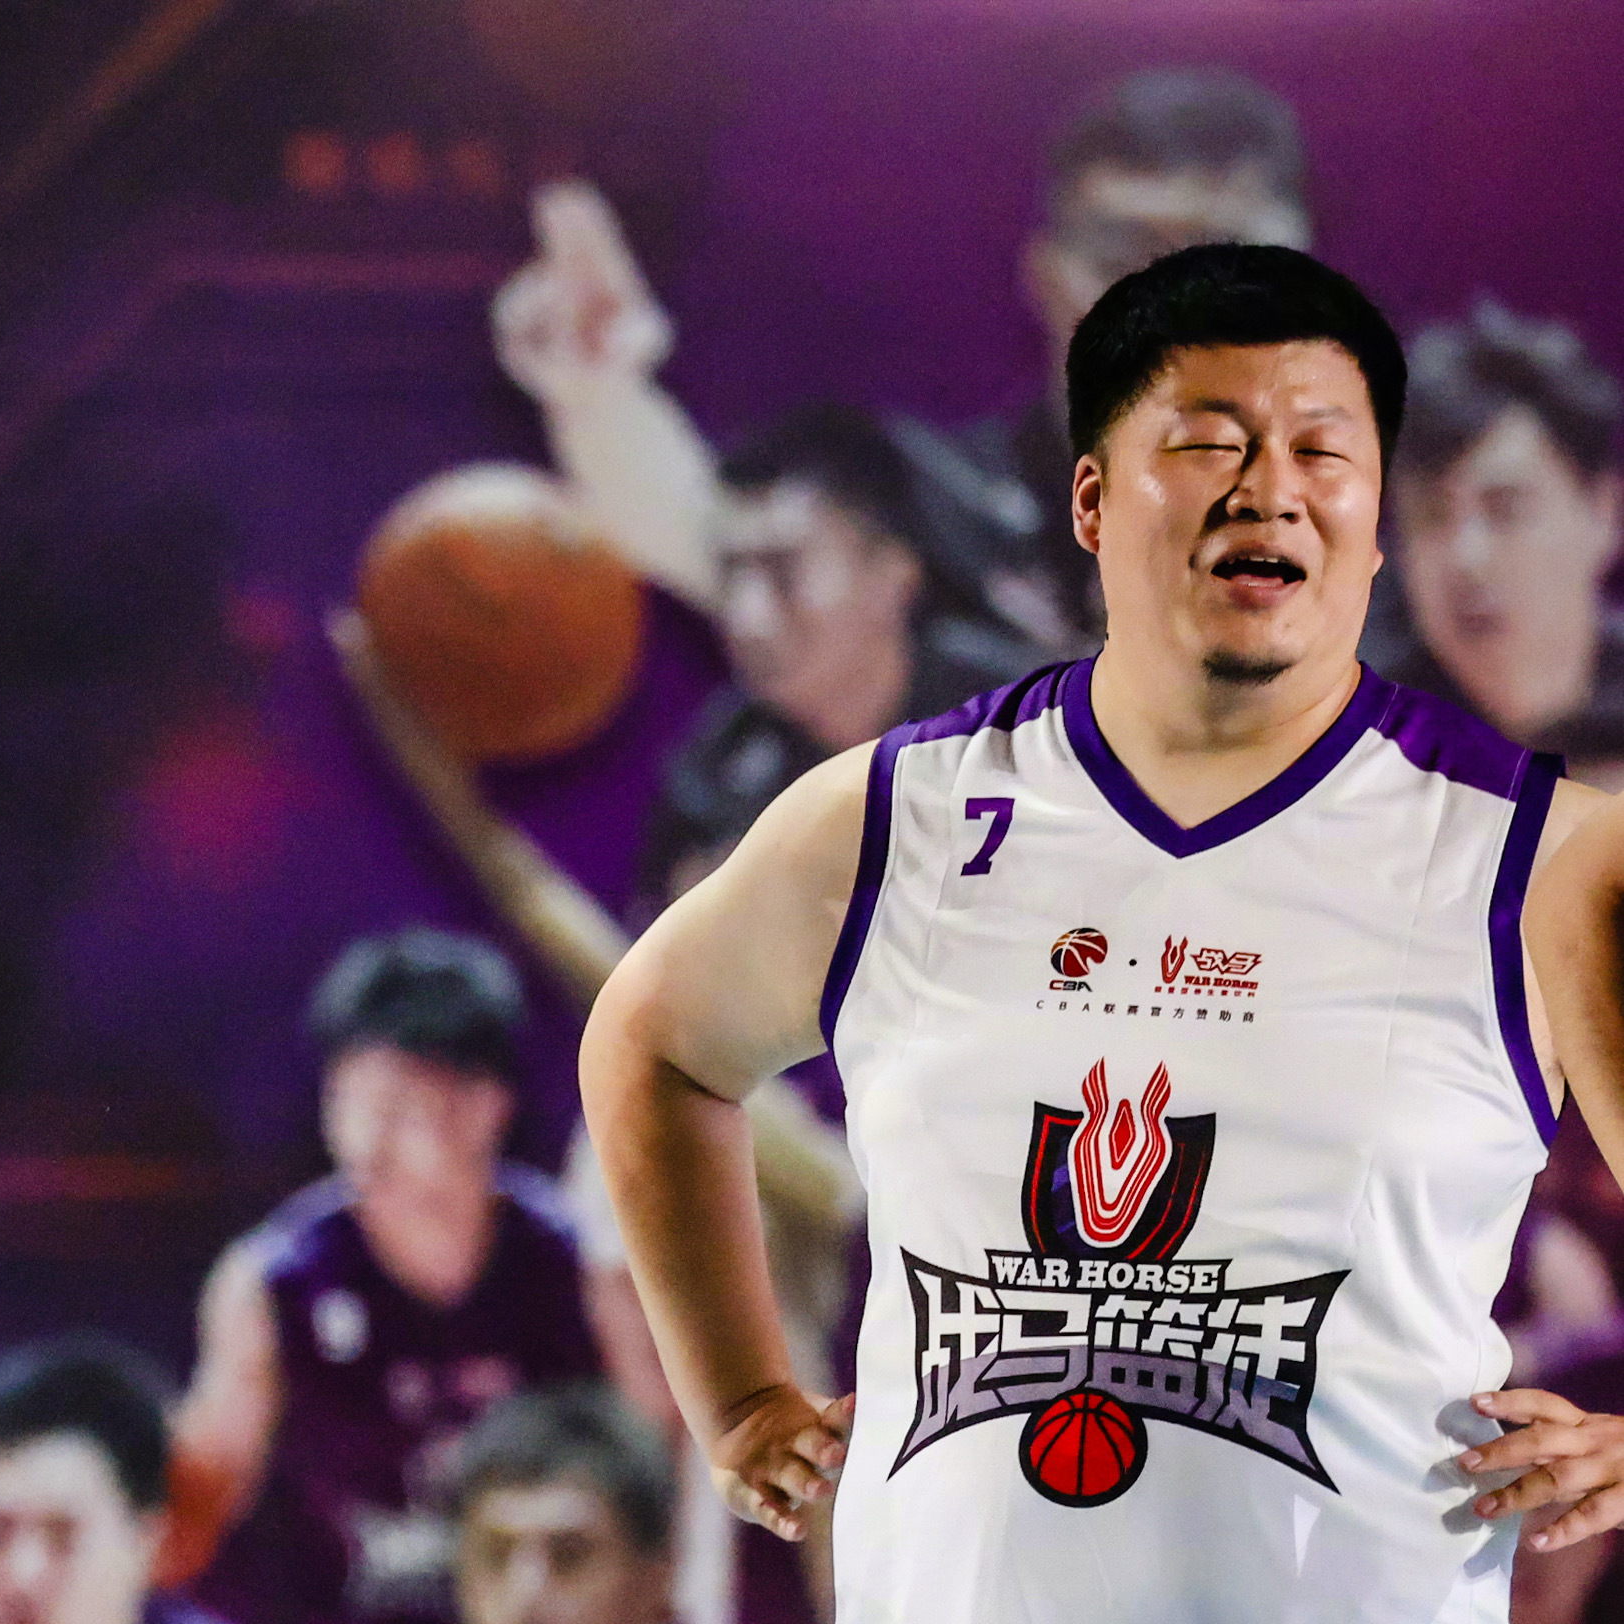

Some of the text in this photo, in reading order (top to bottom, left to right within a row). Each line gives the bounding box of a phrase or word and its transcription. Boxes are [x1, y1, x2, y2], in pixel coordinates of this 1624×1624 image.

[960, 797, 1015, 876] 7
[1049, 978, 1093, 992] CBA
[1184, 975, 1259, 990] WAR HORSE
[991, 1256, 1223, 1294] WAR HORSE
